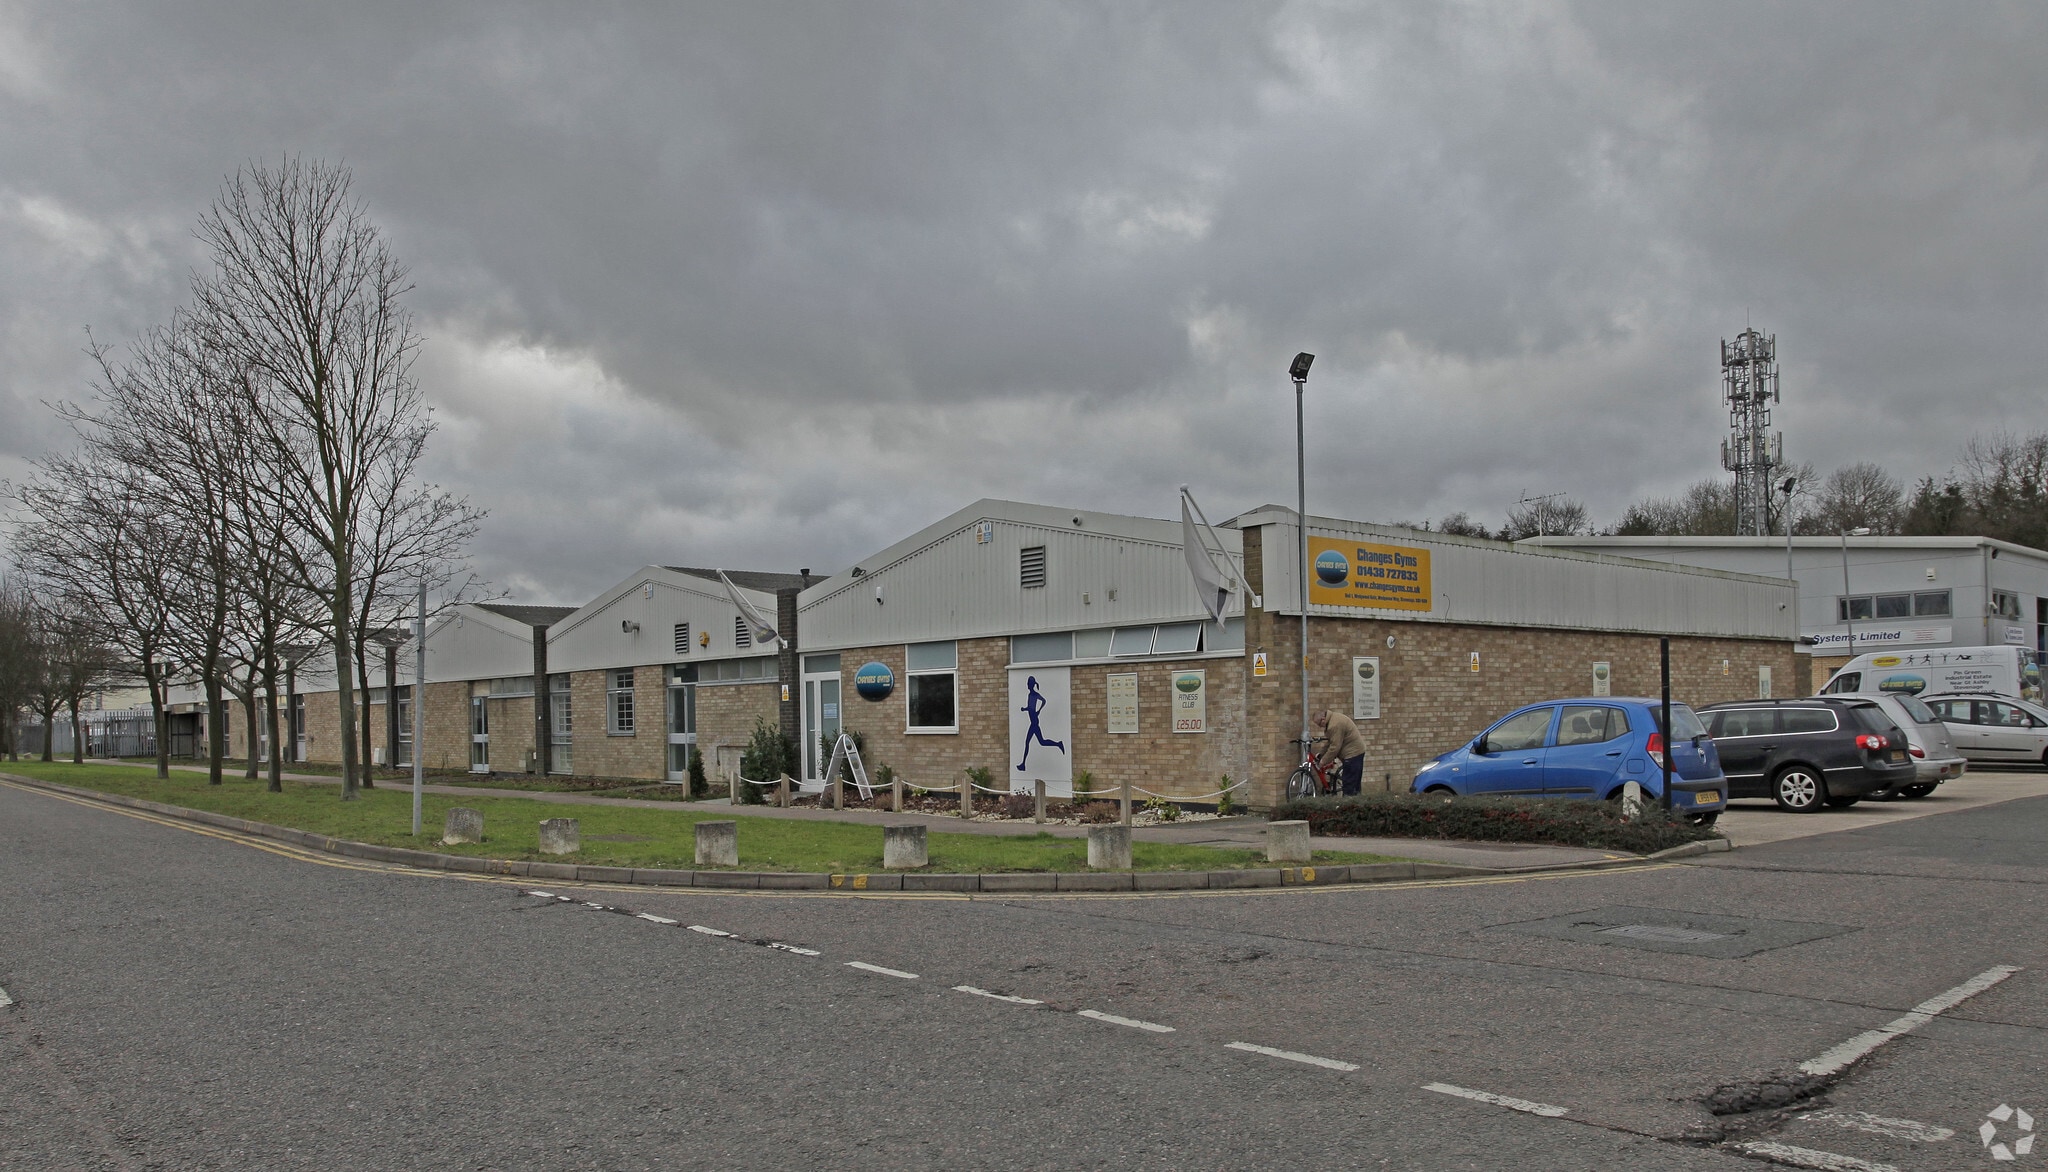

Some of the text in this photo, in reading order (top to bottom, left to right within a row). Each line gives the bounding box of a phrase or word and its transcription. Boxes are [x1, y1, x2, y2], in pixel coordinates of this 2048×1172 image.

[1357, 548, 1417, 567] Changes Gyms
[1357, 565, 1418, 581] 01438 727833
[1354, 581, 1421, 593] www.changesgyms.co.uk
[1813, 633, 1857, 643] Systems
[1860, 631, 1901, 641] Limited
[1176, 719, 1202, 730] £25.00
